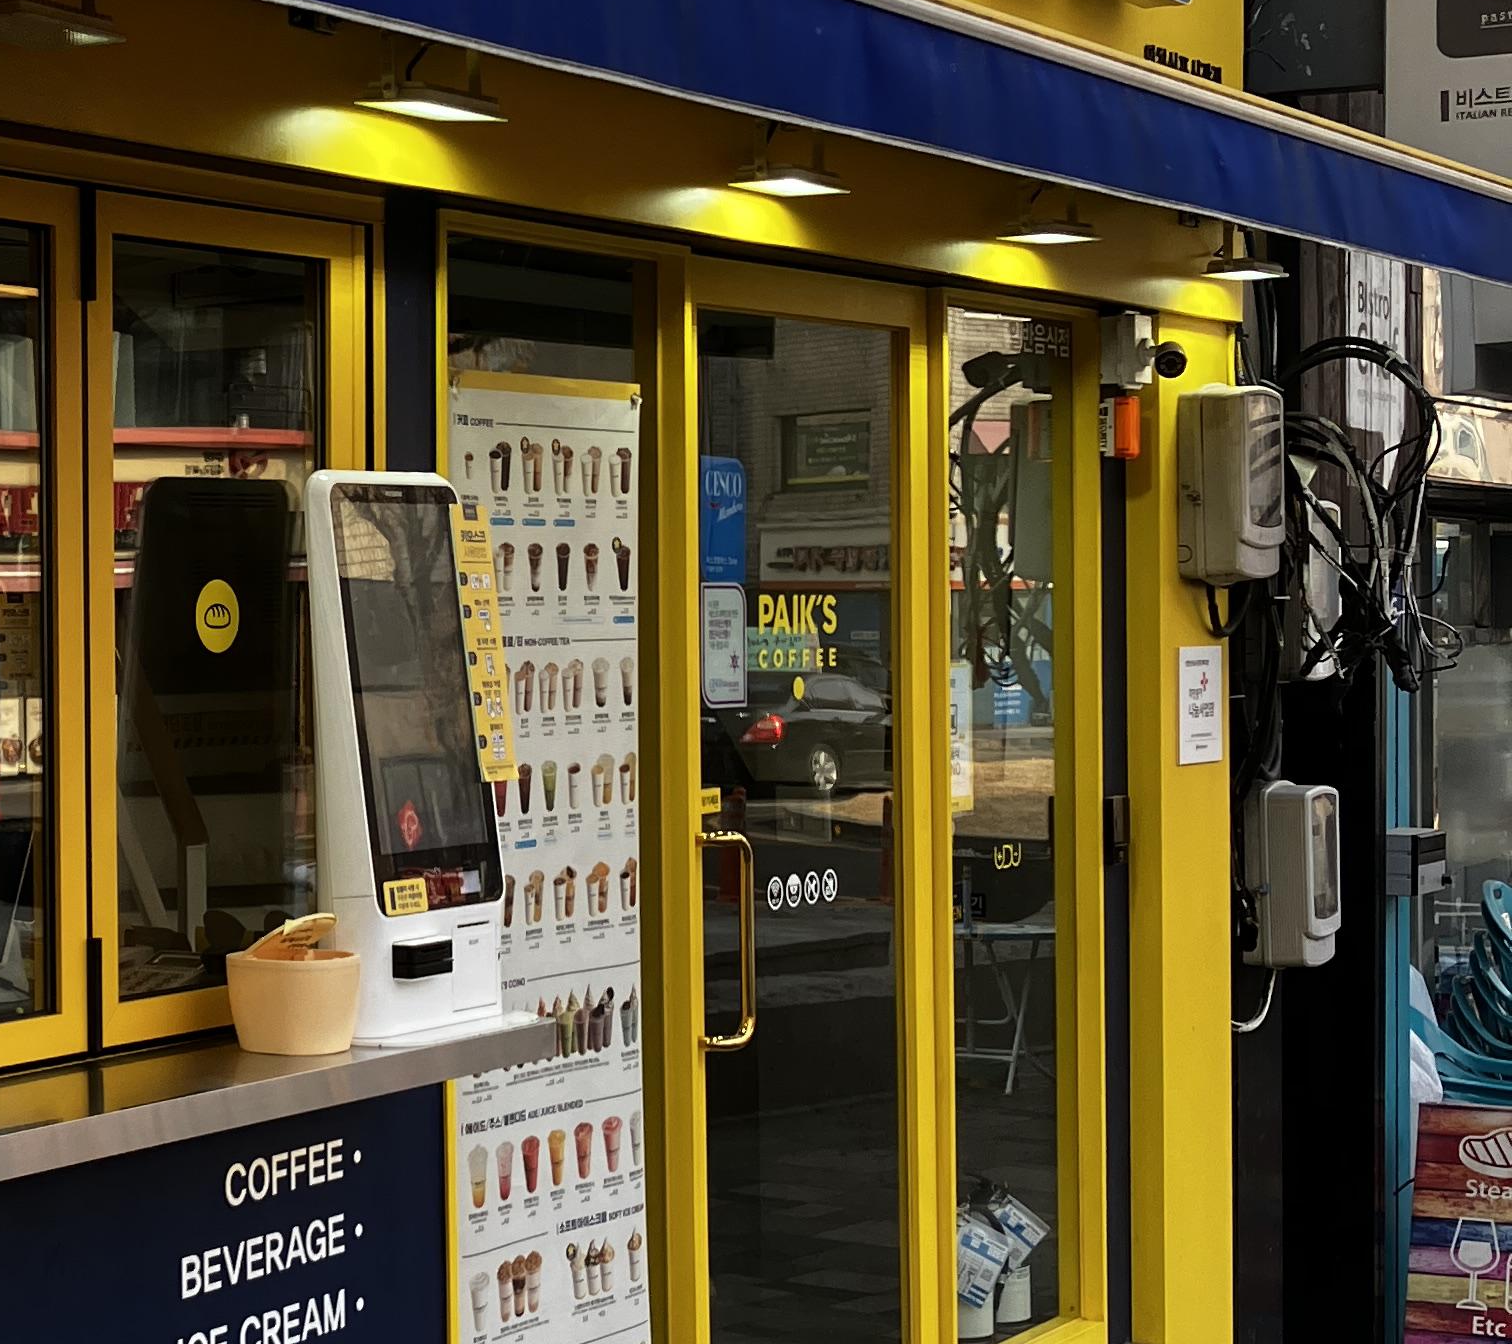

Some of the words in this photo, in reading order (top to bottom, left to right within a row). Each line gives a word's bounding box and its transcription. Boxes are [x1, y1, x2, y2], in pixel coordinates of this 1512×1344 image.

[705, 470, 742, 498] CESCO
[757, 593, 837, 637] PAIK'S
[757, 646, 838, 670] COFFEE
[224, 1138, 344, 1206] COFFEE
[181, 1212, 346, 1300] BEVERAGE
[1472, 1315, 1508, 1338] Etc
